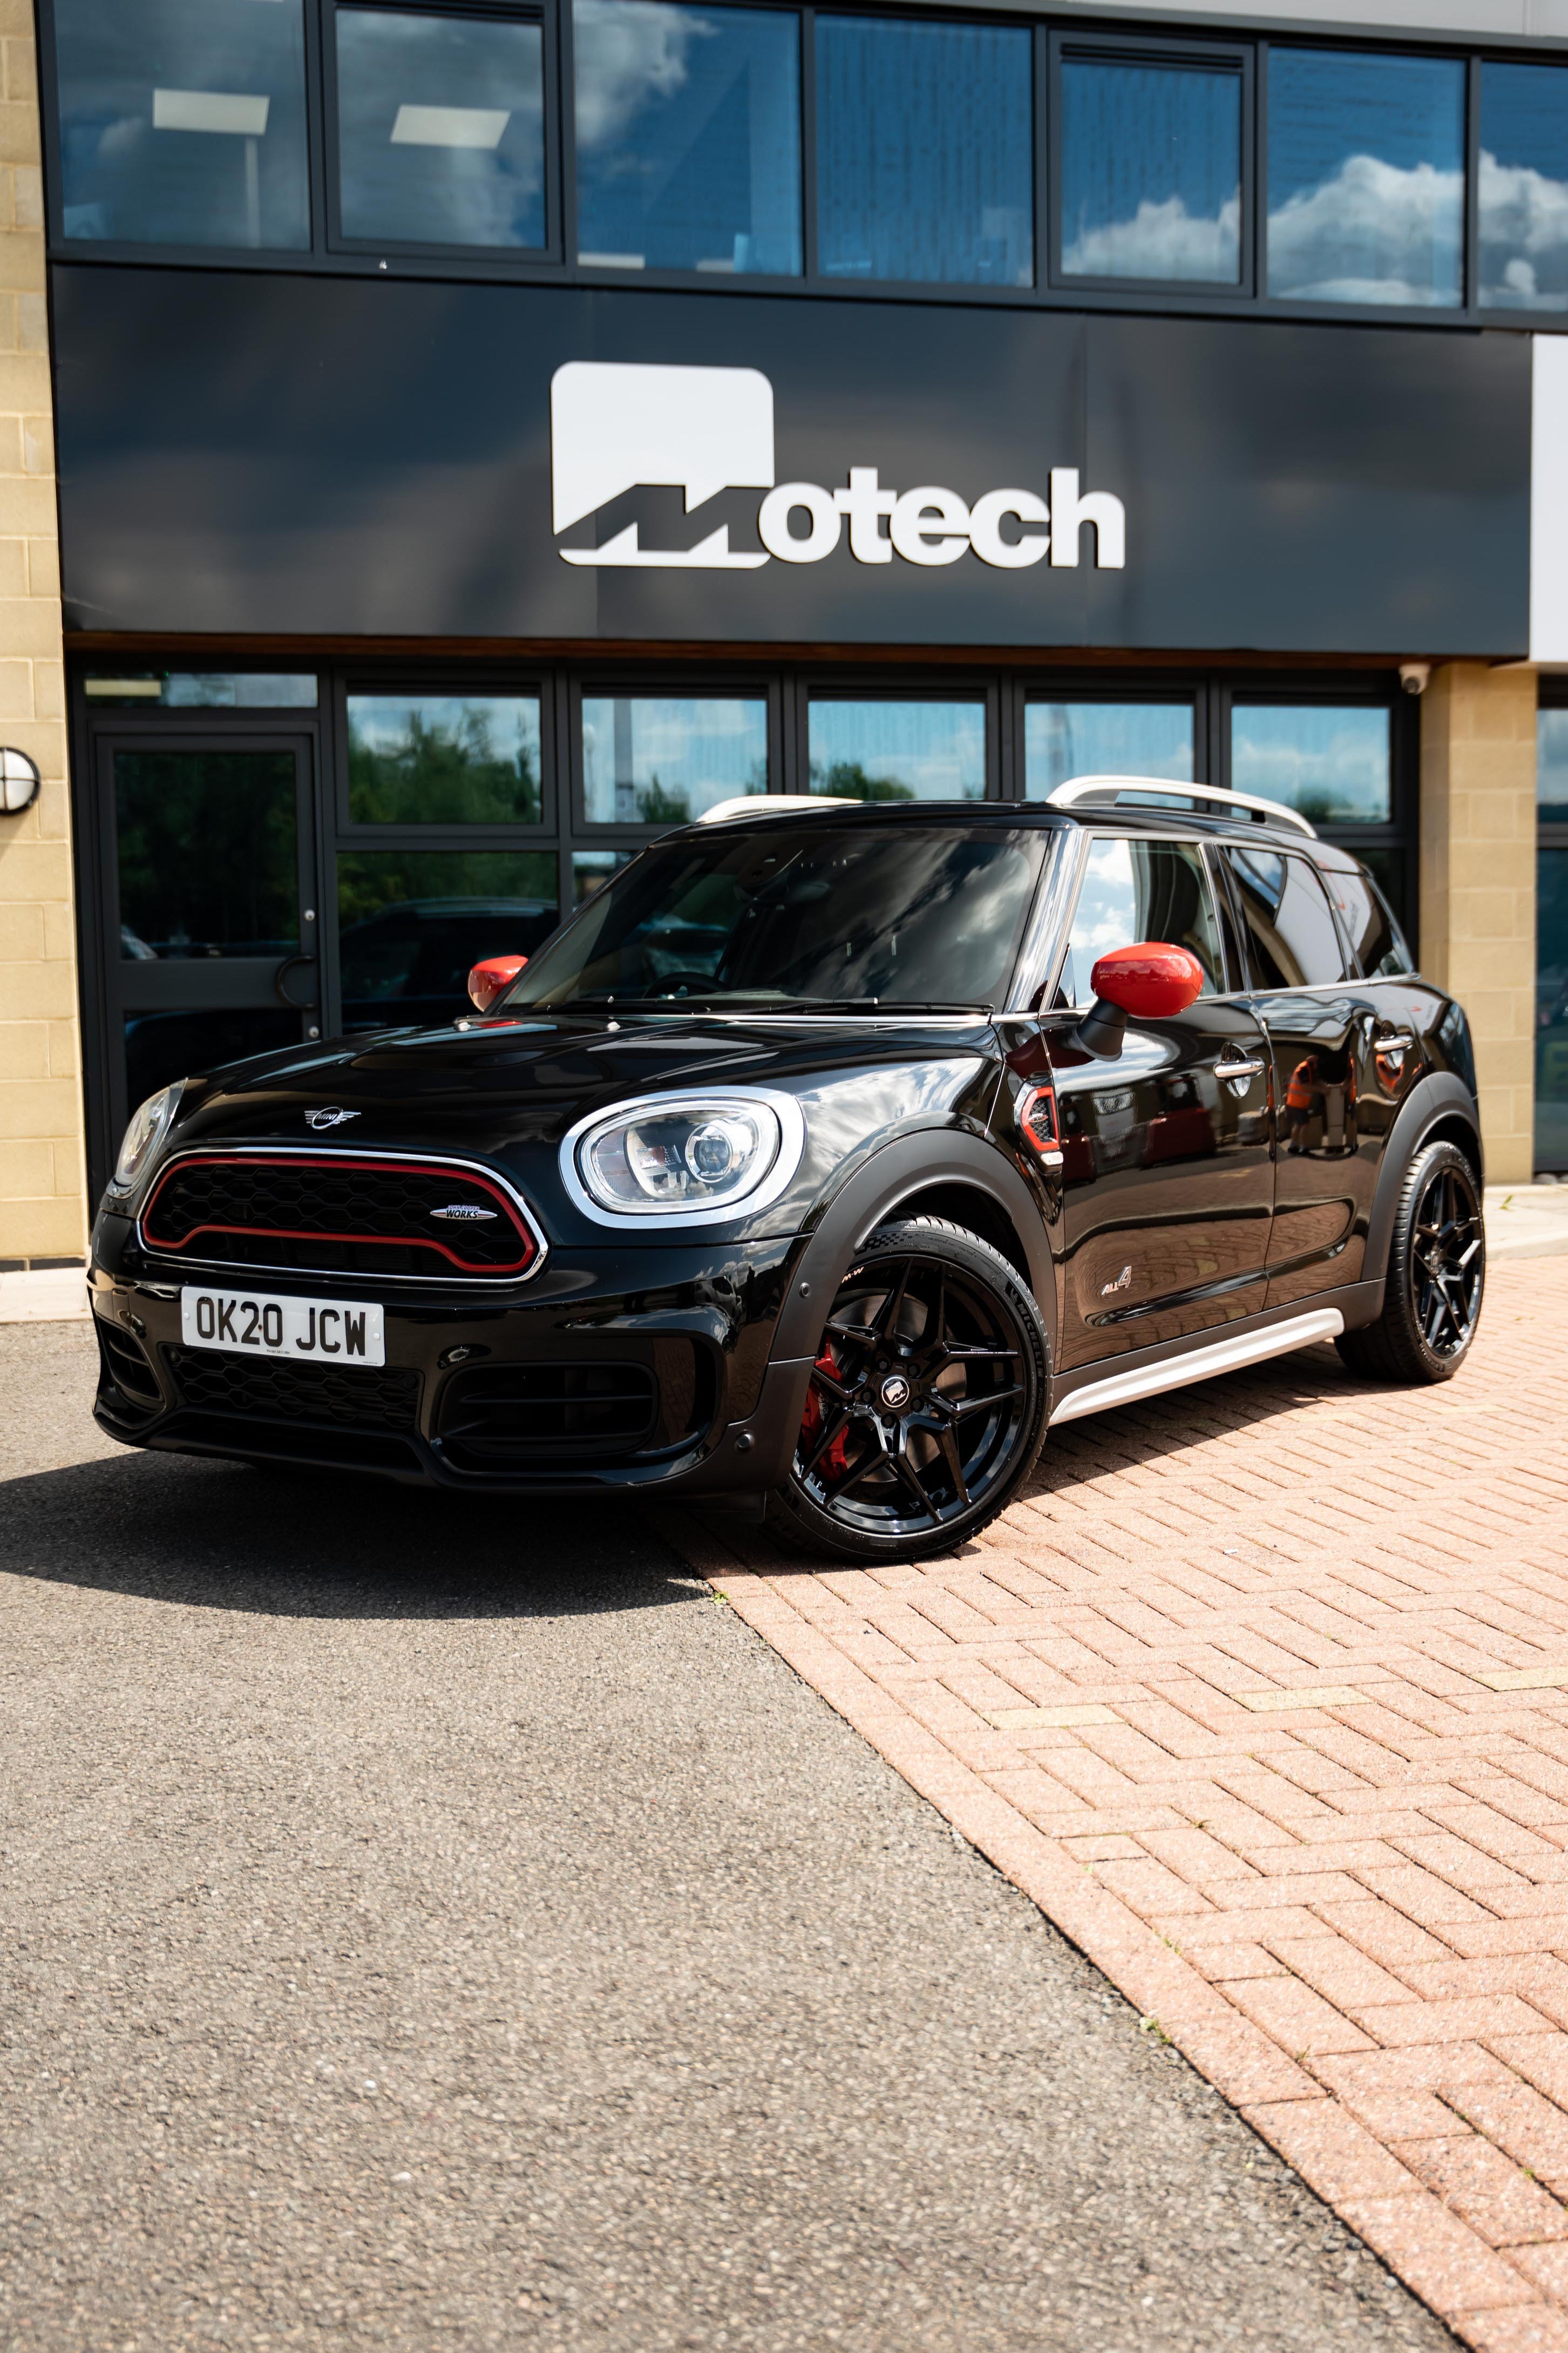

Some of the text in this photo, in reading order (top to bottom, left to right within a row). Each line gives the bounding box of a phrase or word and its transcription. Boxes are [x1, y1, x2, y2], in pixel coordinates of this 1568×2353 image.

[446, 1209, 478, 1219] WORKS
[196, 1296, 366, 1356] OK20 JCW
[1017, 1303, 1044, 1377] MICHELIN
